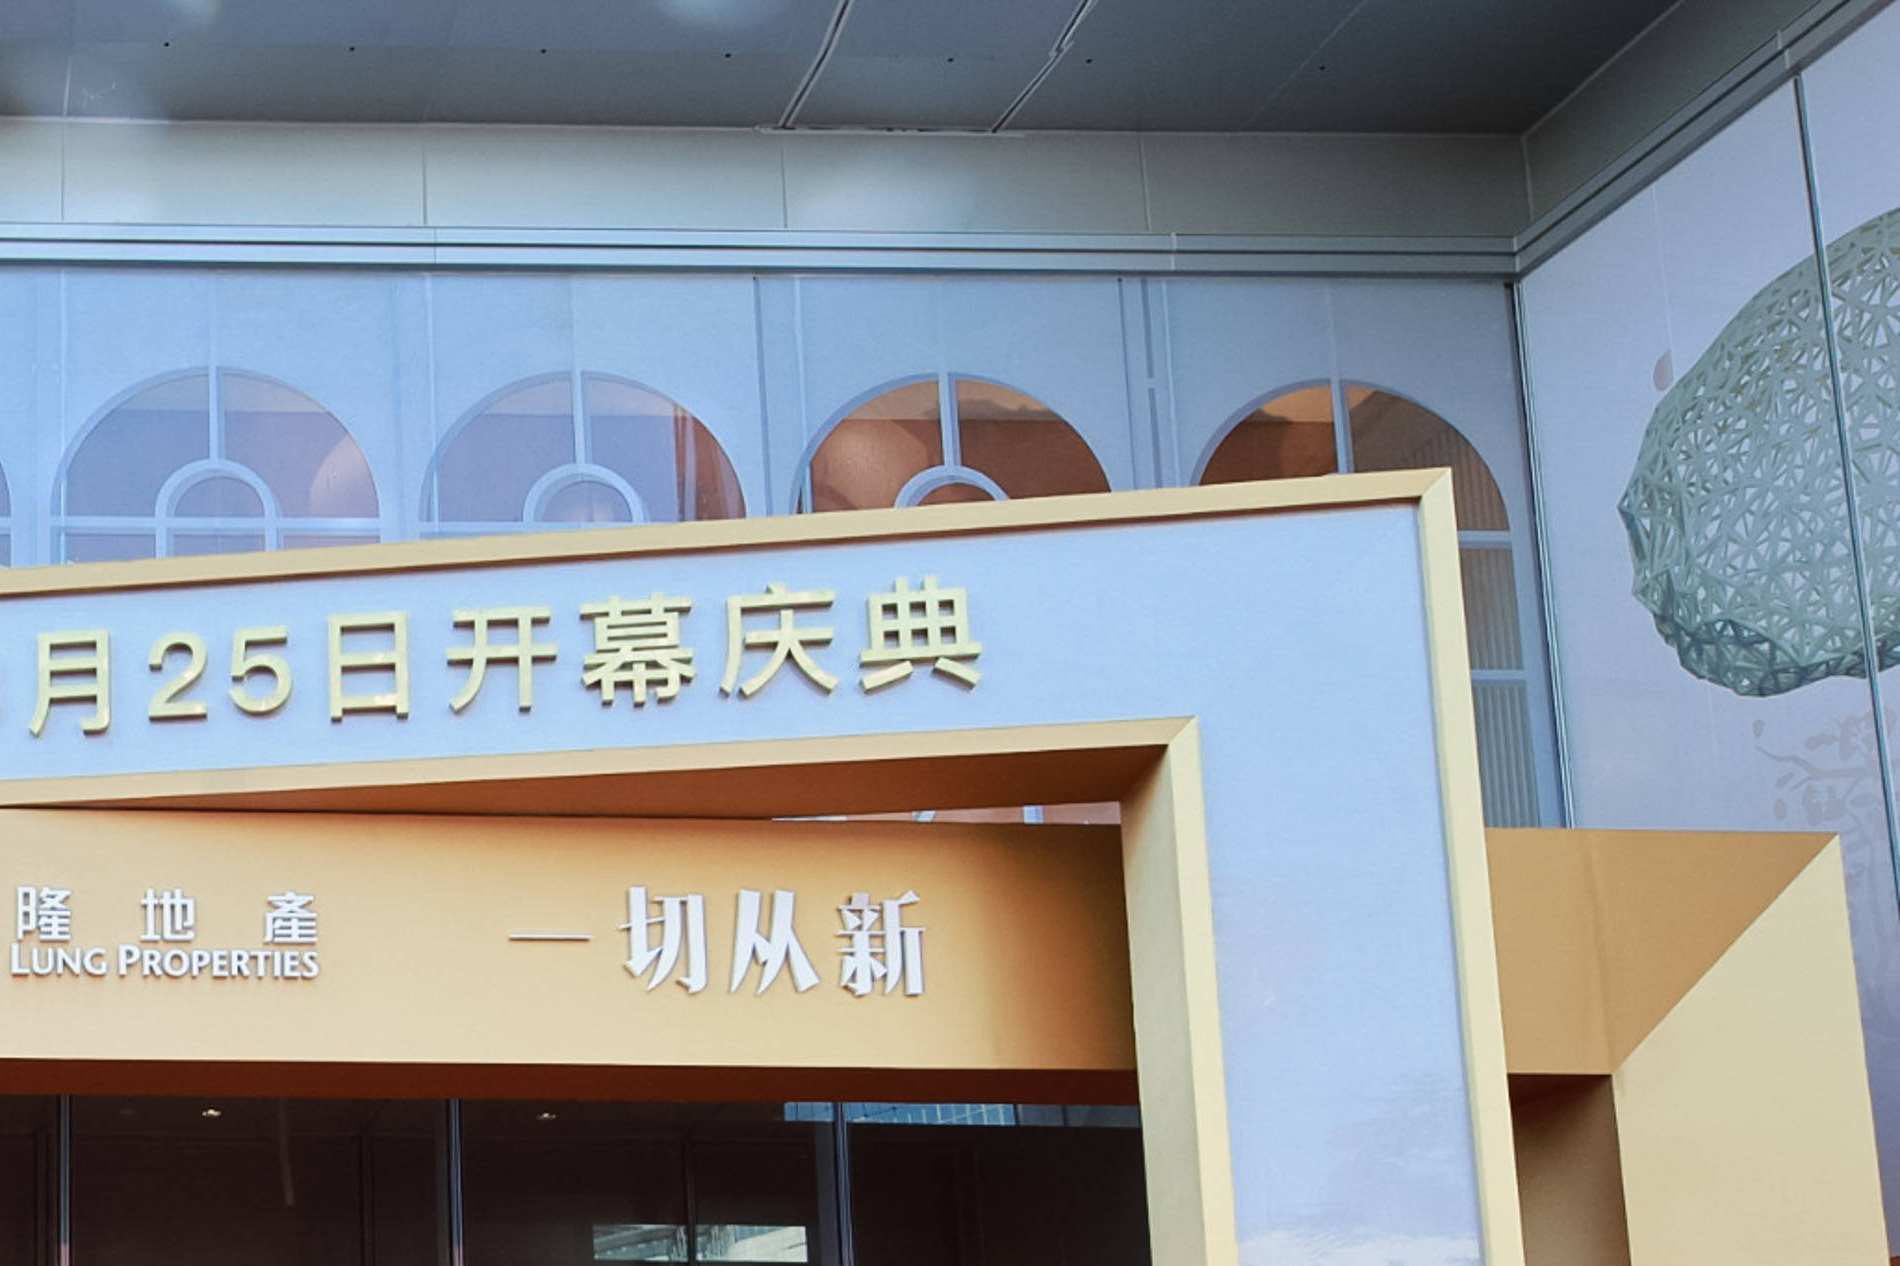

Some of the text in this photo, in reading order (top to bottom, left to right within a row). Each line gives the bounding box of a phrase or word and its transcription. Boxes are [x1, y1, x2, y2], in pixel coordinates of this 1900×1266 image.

[9, 945, 107, 977] LUNG
[117, 944, 320, 980] PROPERTIES
[508, 887, 926, 997] 一切从新
